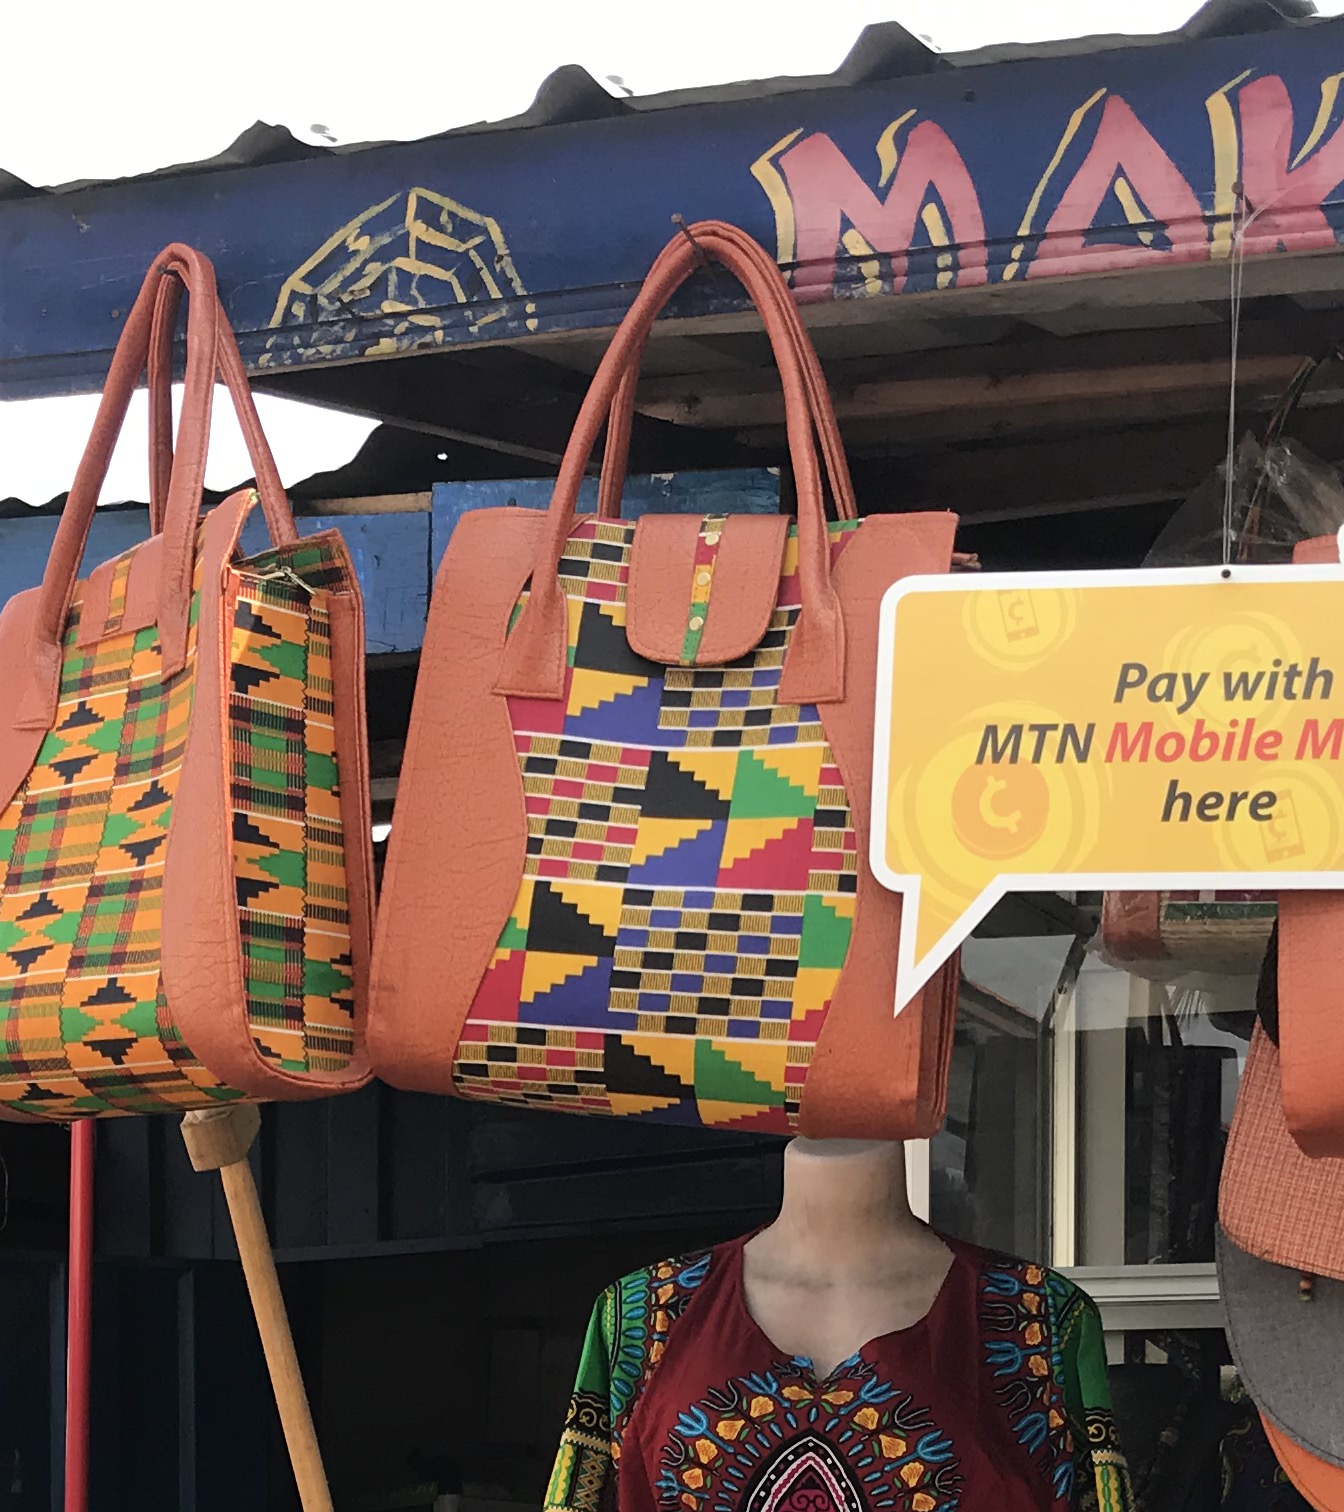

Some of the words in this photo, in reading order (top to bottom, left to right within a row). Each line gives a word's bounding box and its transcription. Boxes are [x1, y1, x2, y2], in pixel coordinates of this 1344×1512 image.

[1113, 661, 1211, 715] Pay
[1222, 657, 1334, 702] with
[974, 722, 1096, 766] MTN
[1104, 718, 1283, 763] Mobile
[1160, 779, 1277, 823] here
